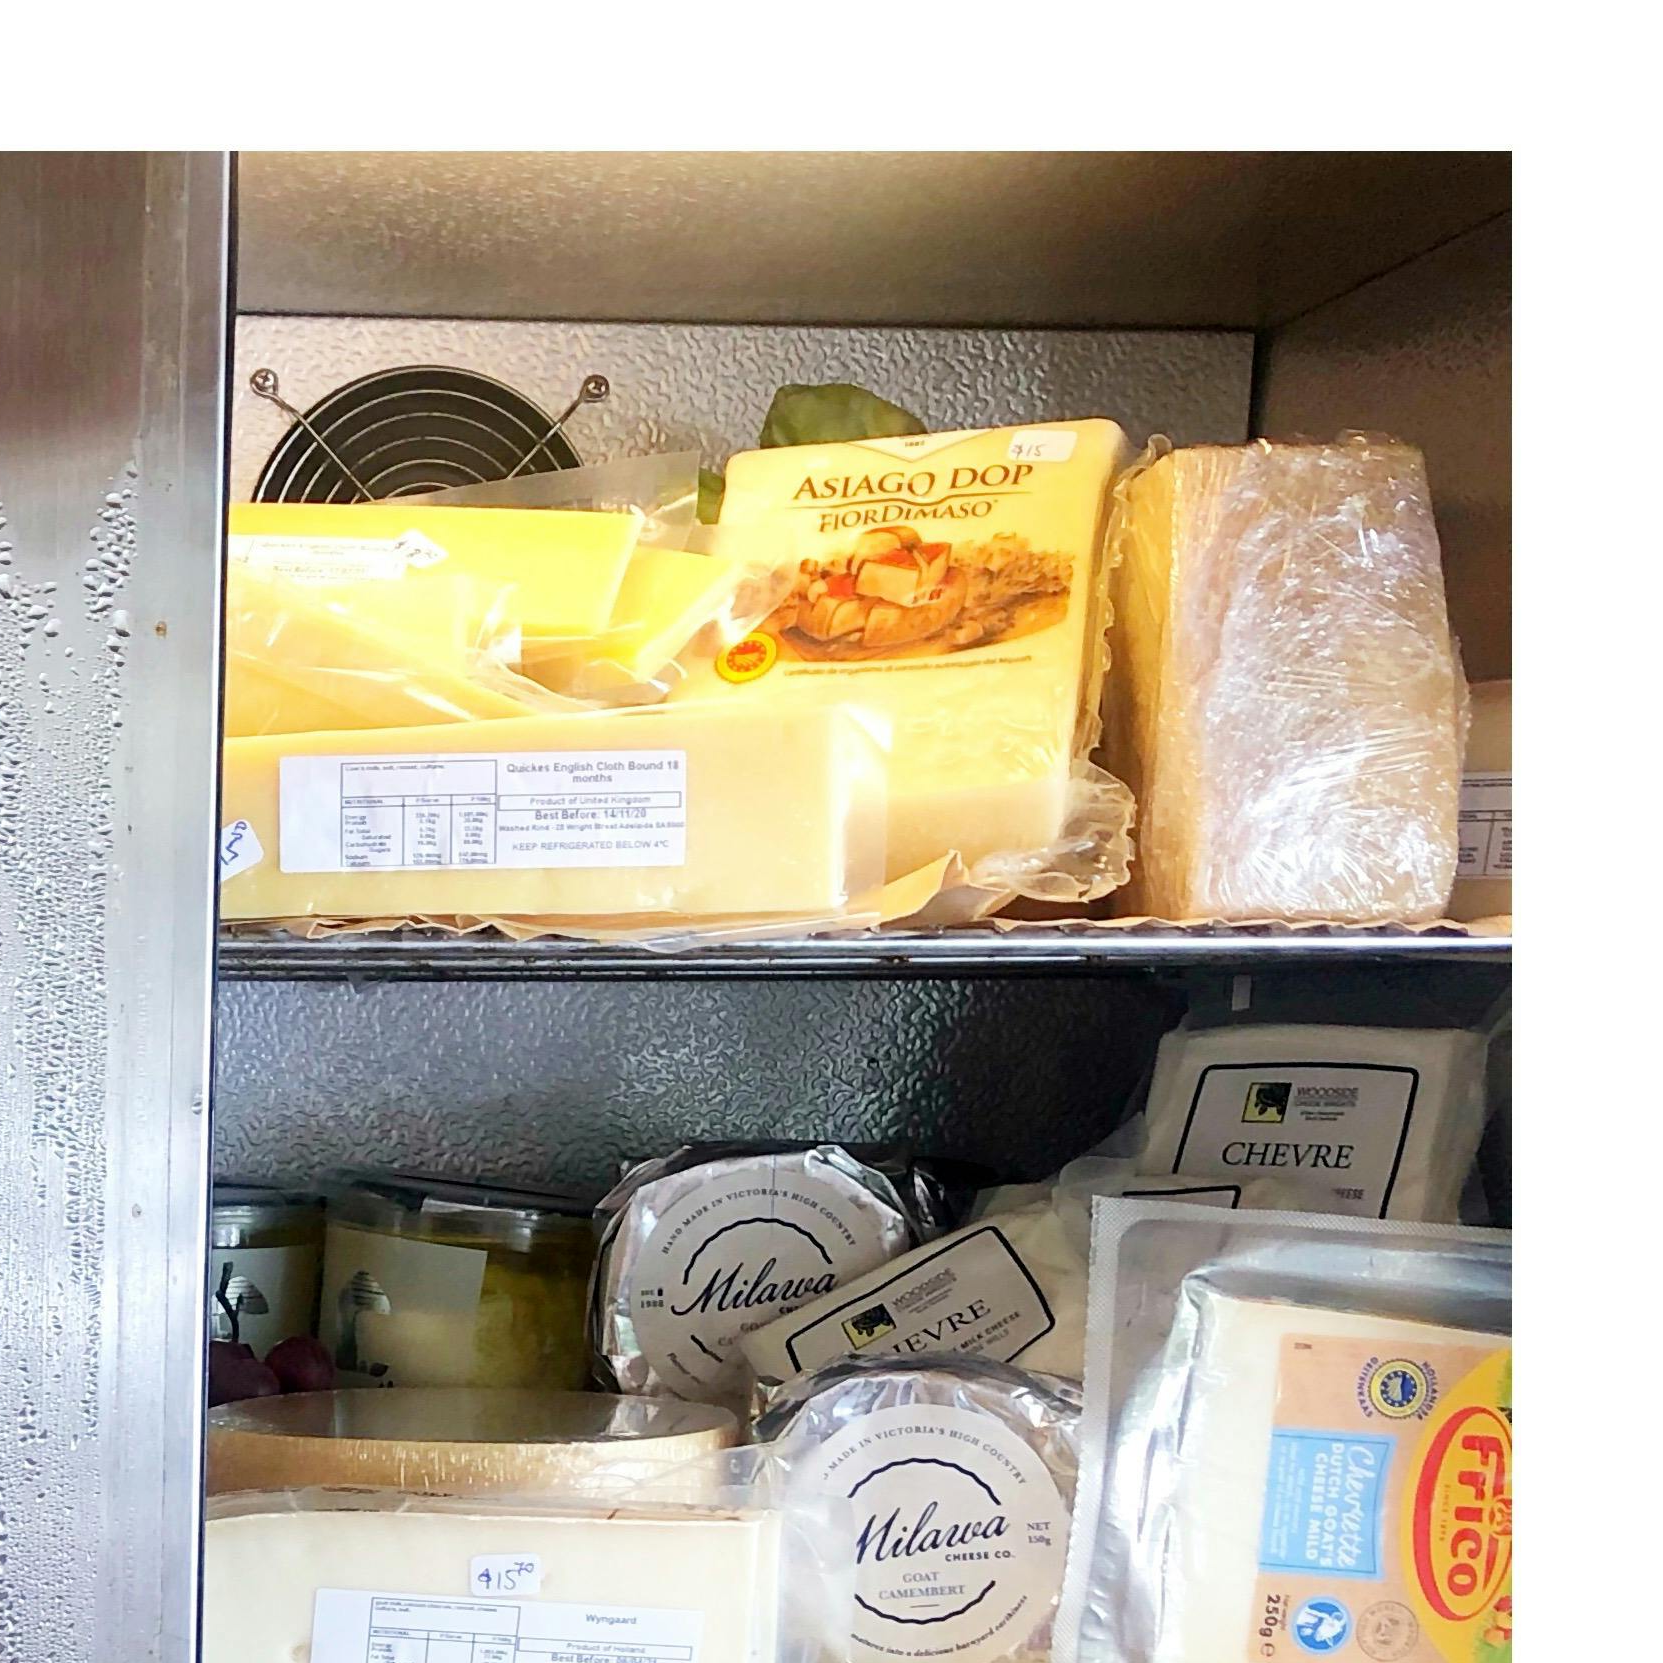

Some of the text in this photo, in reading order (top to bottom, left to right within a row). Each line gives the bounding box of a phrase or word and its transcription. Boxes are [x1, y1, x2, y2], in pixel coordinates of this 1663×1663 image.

[793, 463, 1034, 501] ASIAGO DOP
[506, 763, 550, 773] Quickes
[554, 762, 593, 774] English
[596, 761, 624, 771] Cloth
[628, 761, 664, 771] Bound
[572, 774, 613, 783] months
[535, 810, 559, 820] Best
[541, 840, 613, 850] REFRIGERATED
[615, 840, 651, 849] BELOW
[1297, 1087, 1359, 1098] WOODSIDE
[1222, 1141, 1355, 1169] CHEVRE
[662, 1228, 684, 1254] HAND
[683, 1205, 710, 1227] MADE
[726, 1187, 788, 1202] VICTORIA'S
[791, 1192, 819, 1210] HIGH
[819, 1207, 857, 1247] COUNTRY
[671, 1257, 836, 1316] Milawa
[983, 1311, 1021, 1337] CHEESE
[827, 1425, 1027, 1485] MADE IN VICTORIA'S HIGH COUNTRY
[1325, 1442, 1345, 1498] DUTCH
[1306, 1452, 1328, 1561] CHEESE MILD
[1337, 1444, 1375, 1568] Chevrette
[1447, 1435, 1505, 1597] Frico
[1026, 1521, 1051, 1532] NET
[945, 1551, 989, 1563] CHEESE
[902, 1571, 940, 1584] GOAT
[878, 1584, 966, 1601] CAMEMBERT
[585, 1613, 637, 1625] Wyngaard
[1259, 1594, 1281, 1640] 250g
[551, 1653, 574, 1663] Best
